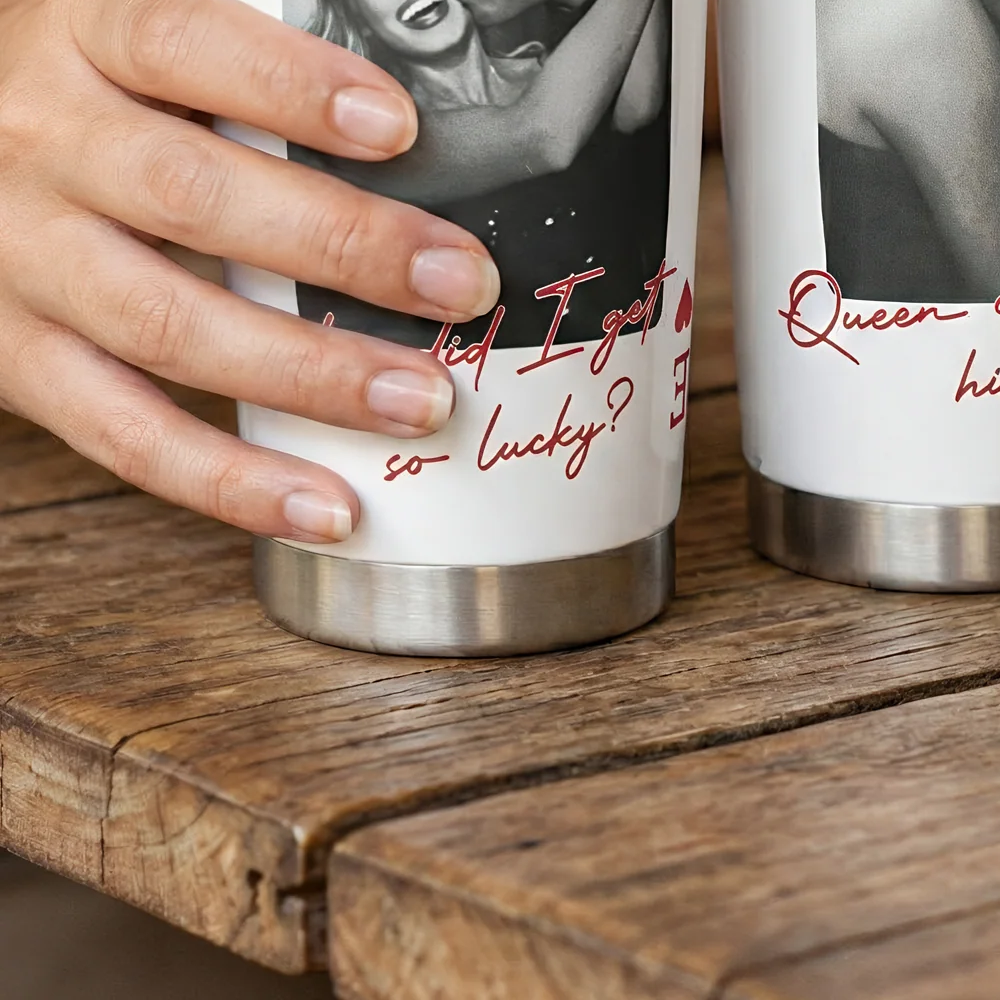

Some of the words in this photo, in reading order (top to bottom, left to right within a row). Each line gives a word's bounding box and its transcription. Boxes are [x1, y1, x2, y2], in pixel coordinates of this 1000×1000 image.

[516, 266, 606, 375] I
[590, 258, 678, 376] get
[777, 269, 968, 366] Queen
[383, 453, 450, 482] so
[477, 376, 635, 480] lucky?
